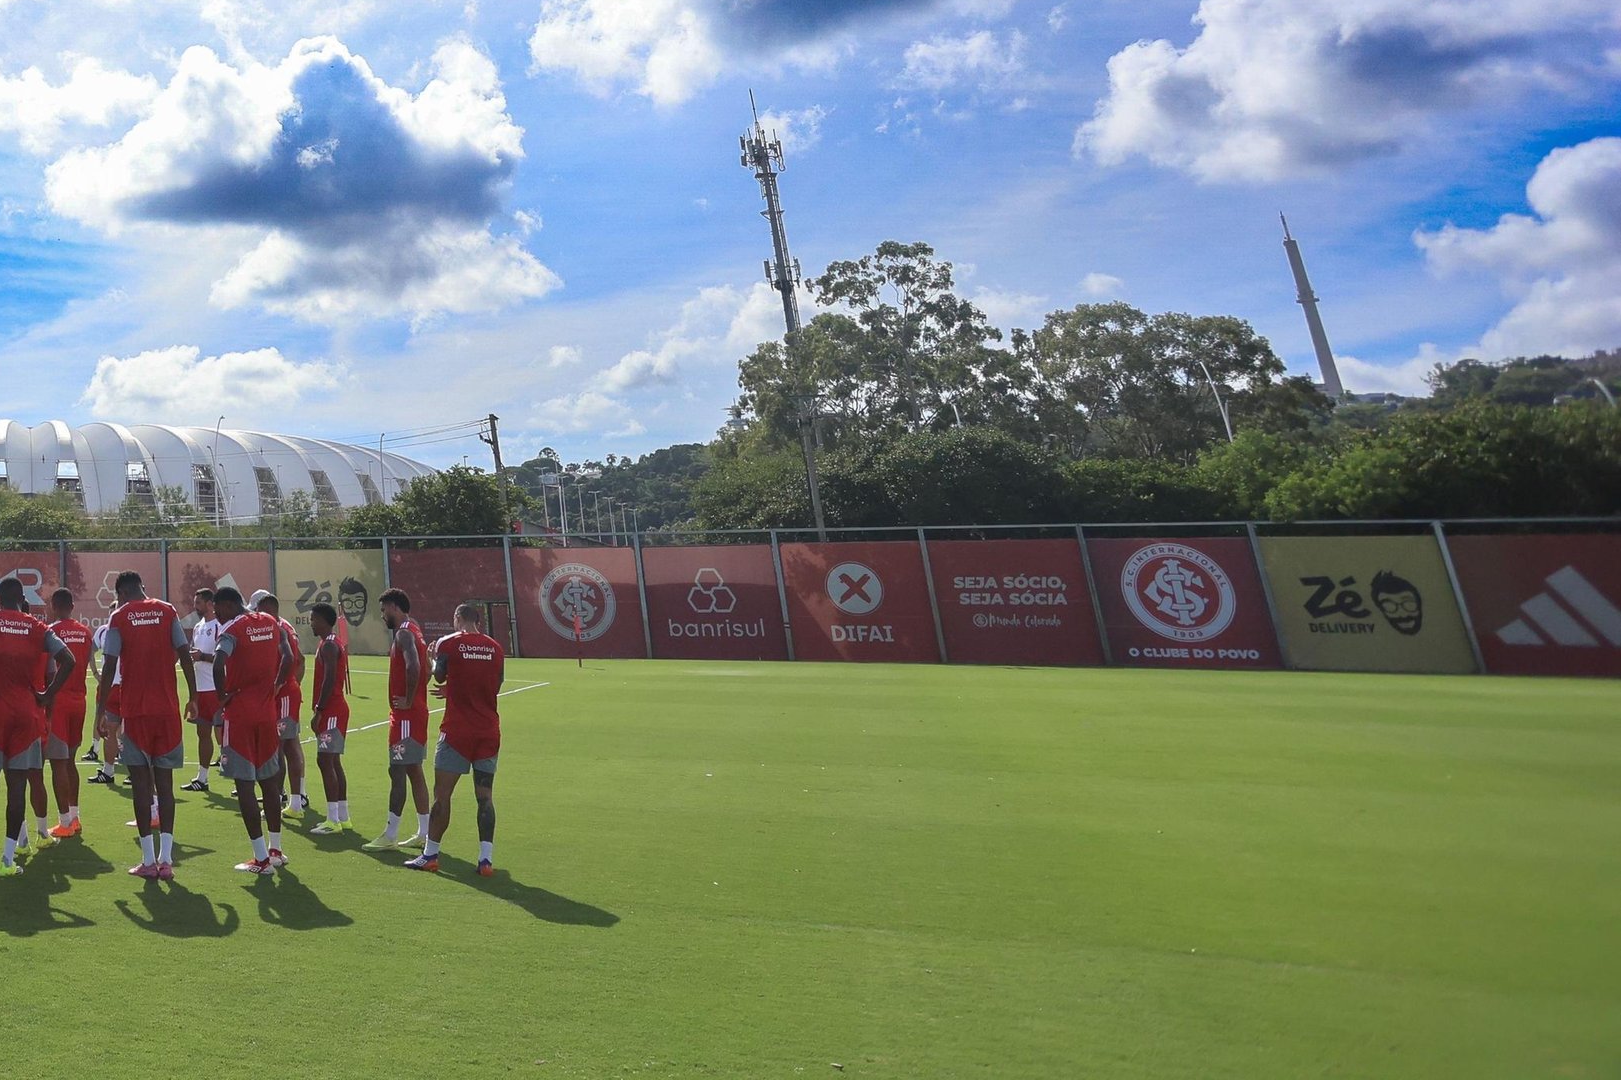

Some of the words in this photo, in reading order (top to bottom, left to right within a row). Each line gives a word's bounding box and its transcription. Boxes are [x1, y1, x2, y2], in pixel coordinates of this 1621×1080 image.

[953, 576, 998, 589] SEJA
[1002, 573, 1067, 591] SÓCIO,
[960, 593, 1005, 605] SEJA
[1009, 590, 1068, 605] SÓCIA
[1299, 575, 1372, 619] Zé
[135, 610, 164, 618] banrisul
[131, 618, 160, 626] Unimed
[0, 626, 29, 635] Unimed
[668, 618, 765, 638] banrisul
[1308, 622, 1375, 633] DELIVERY
[250, 633, 273, 642] Unimed
[830, 624, 895, 642] DIFAI
[1173, 630, 1204, 638] 1909
[467, 644, 496, 653] banrisul
[1128, 647, 1140, 657] O
[1143, 648, 1190, 658] CLUBE
[1192, 648, 1215, 658] DO
[1218, 649, 1260, 659] POVO
[462, 652, 492, 660] Unimed
